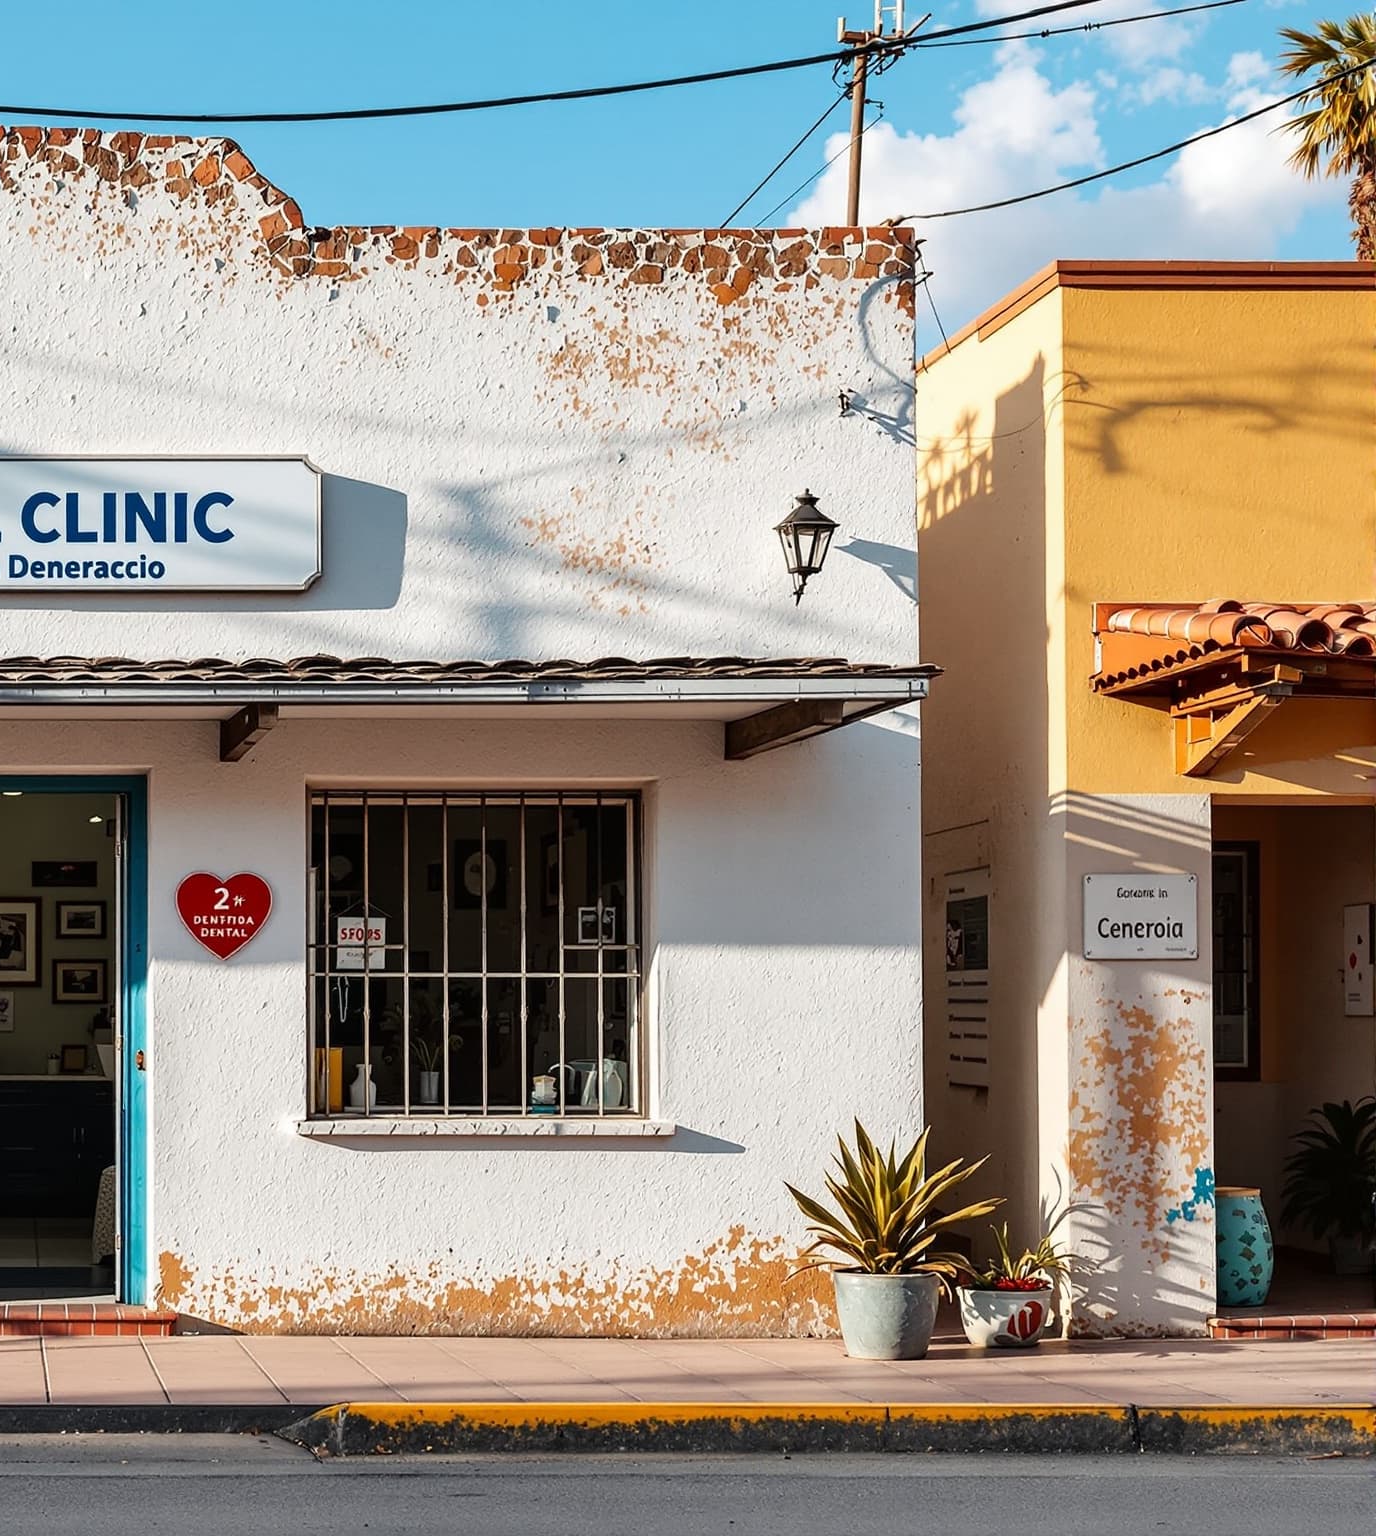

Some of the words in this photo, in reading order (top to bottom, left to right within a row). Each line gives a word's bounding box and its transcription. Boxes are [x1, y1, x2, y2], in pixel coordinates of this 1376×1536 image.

[21, 492, 235, 543] CLINIC
[8, 554, 166, 579] Deneraccio
[200, 928, 248, 937] DENTAL
[1097, 916, 1183, 938] Ceneroia
